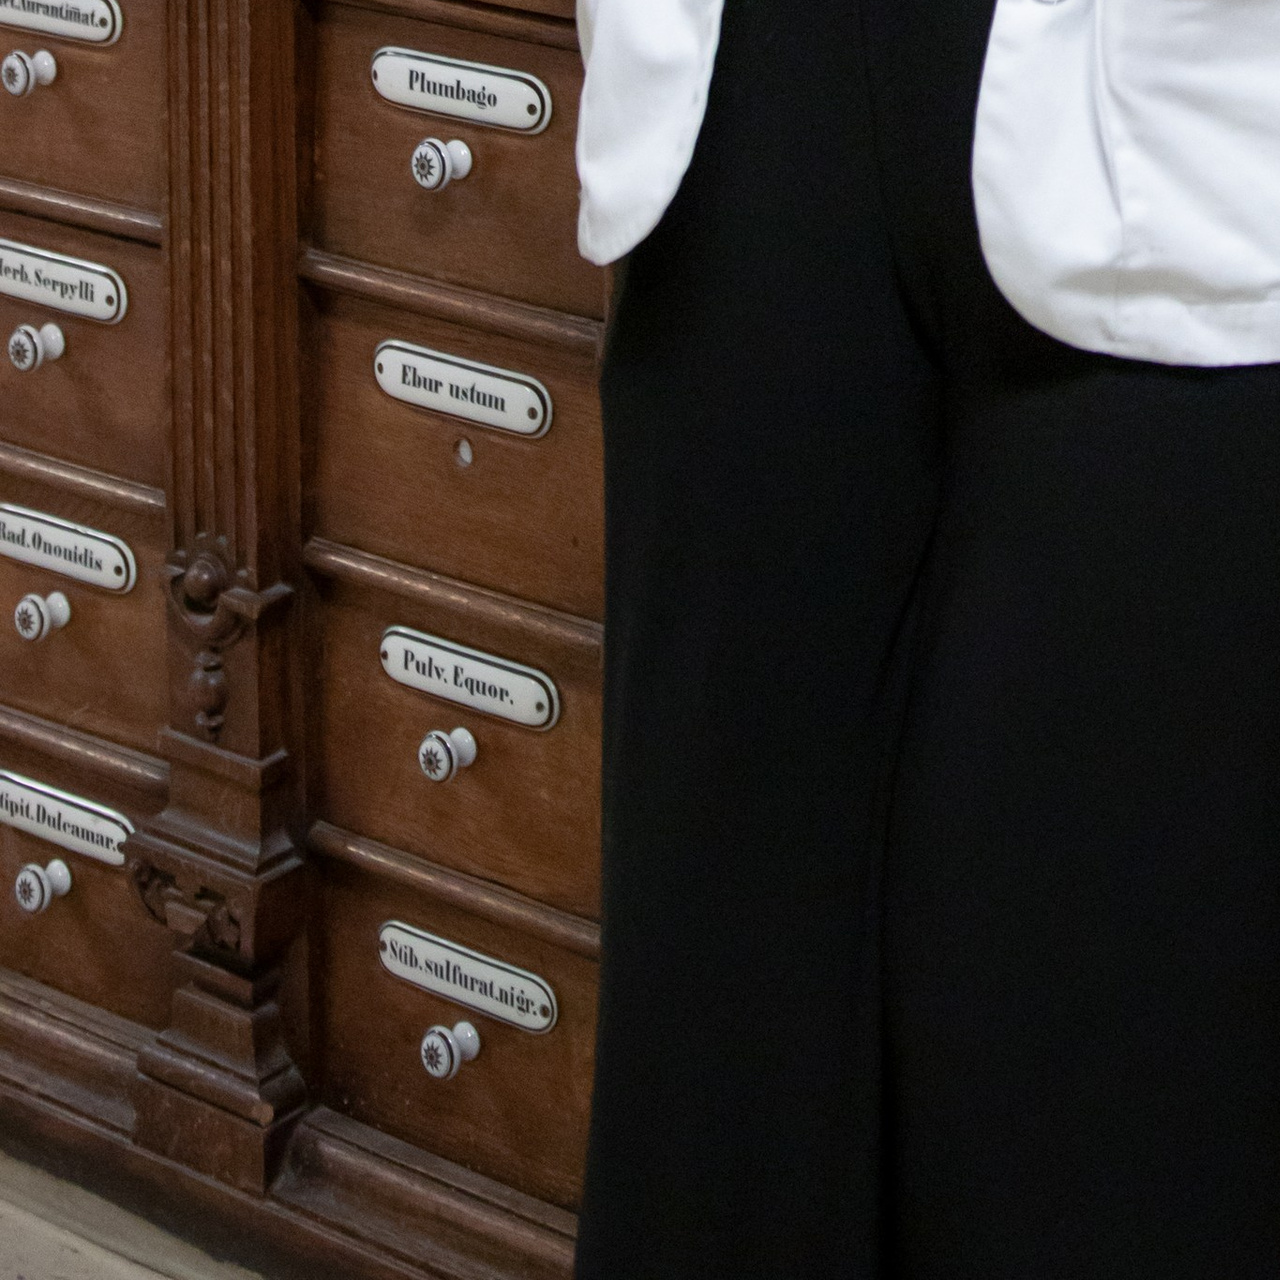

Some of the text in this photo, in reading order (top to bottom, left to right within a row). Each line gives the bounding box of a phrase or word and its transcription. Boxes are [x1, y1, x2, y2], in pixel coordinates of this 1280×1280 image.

[408, 68, 498, 110] Plumbago
[0, 258, 94, 302] erb. Serpylli
[401, 363, 507, 413] Ebur ustum
[32, 531, 103, 572] Ononidis
[403, 648, 514, 706] Pulv. Equor.
[36, 803, 117, 852] Dulcamar.
[389, 938, 539, 1018] Stib. sulfurat. nigr.
